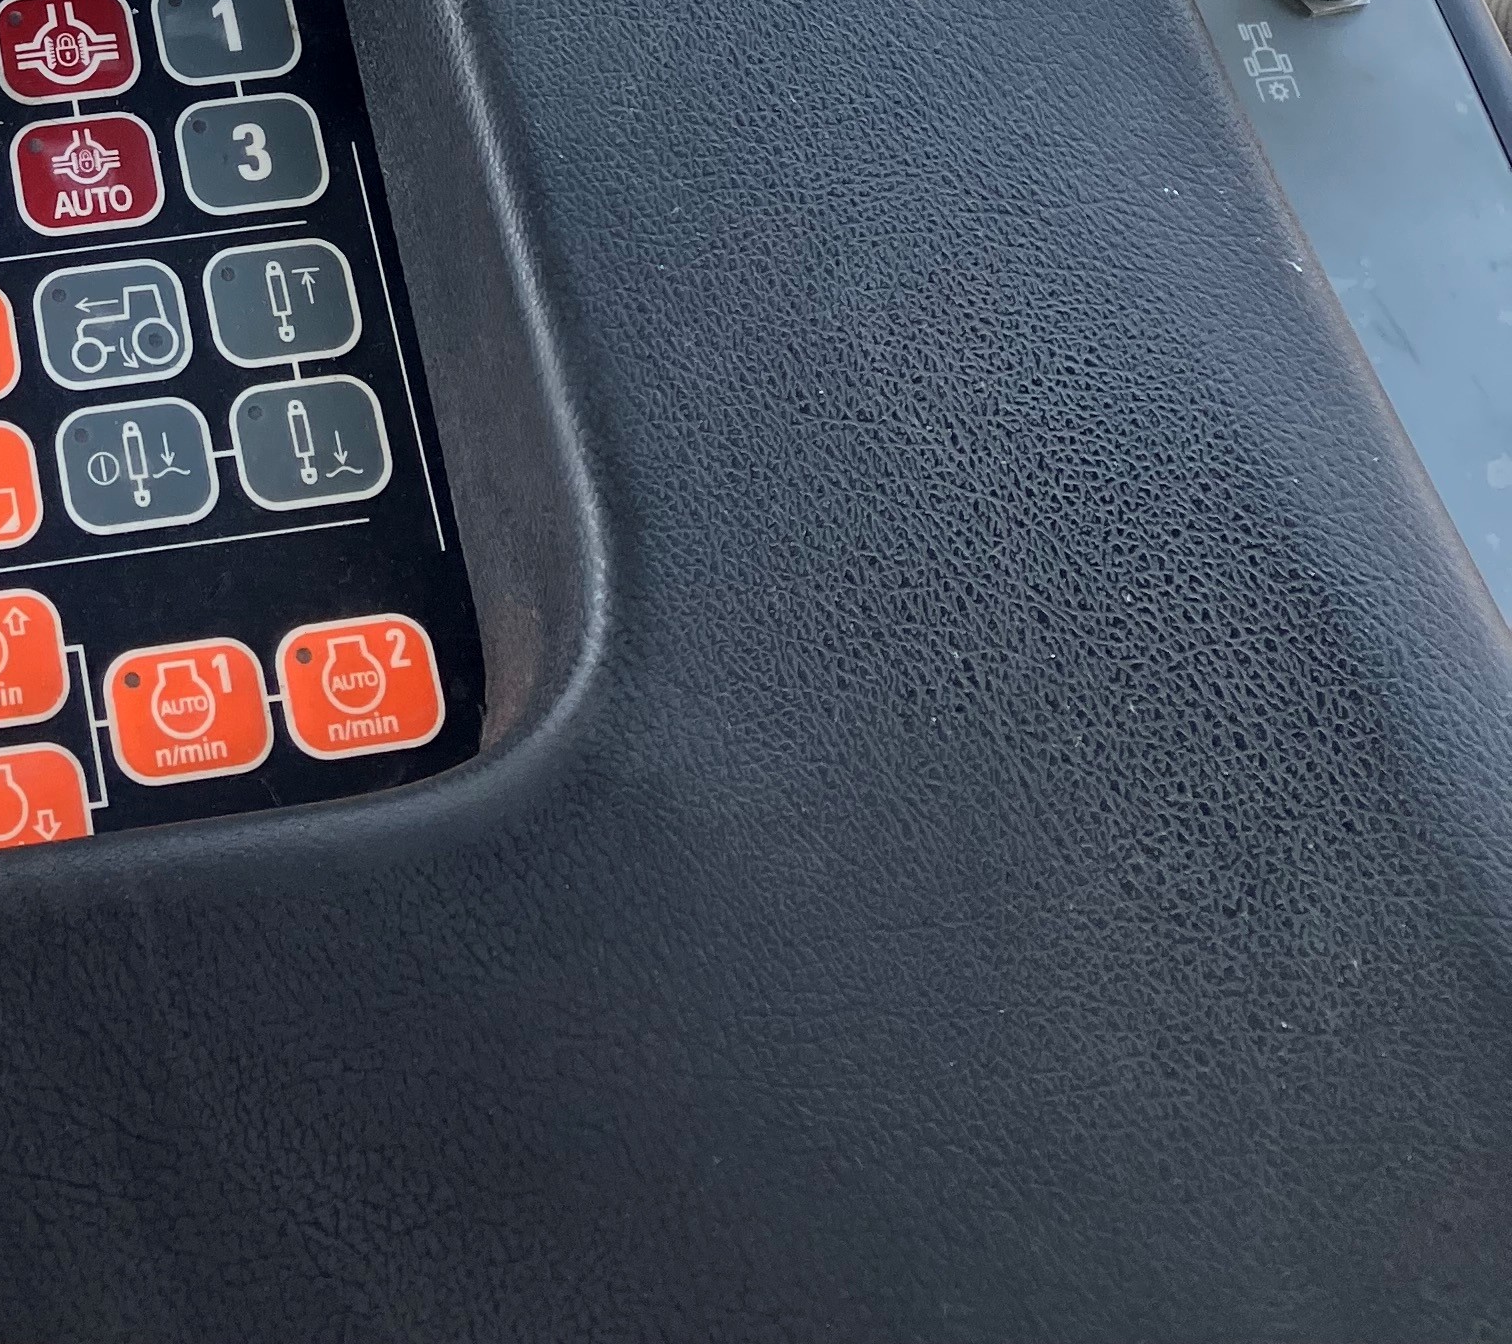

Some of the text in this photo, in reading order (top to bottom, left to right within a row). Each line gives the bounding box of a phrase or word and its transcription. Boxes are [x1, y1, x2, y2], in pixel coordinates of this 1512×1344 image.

[232, 122, 272, 181] 3
[54, 184, 133, 220] AUTO
[385, 627, 412, 669] 2
[211, 653, 233, 694] 1
[331, 669, 378, 692] AUTO
[160, 695, 208, 716] AUTO
[327, 711, 399, 742] n/min
[155, 736, 228, 768] n/min
